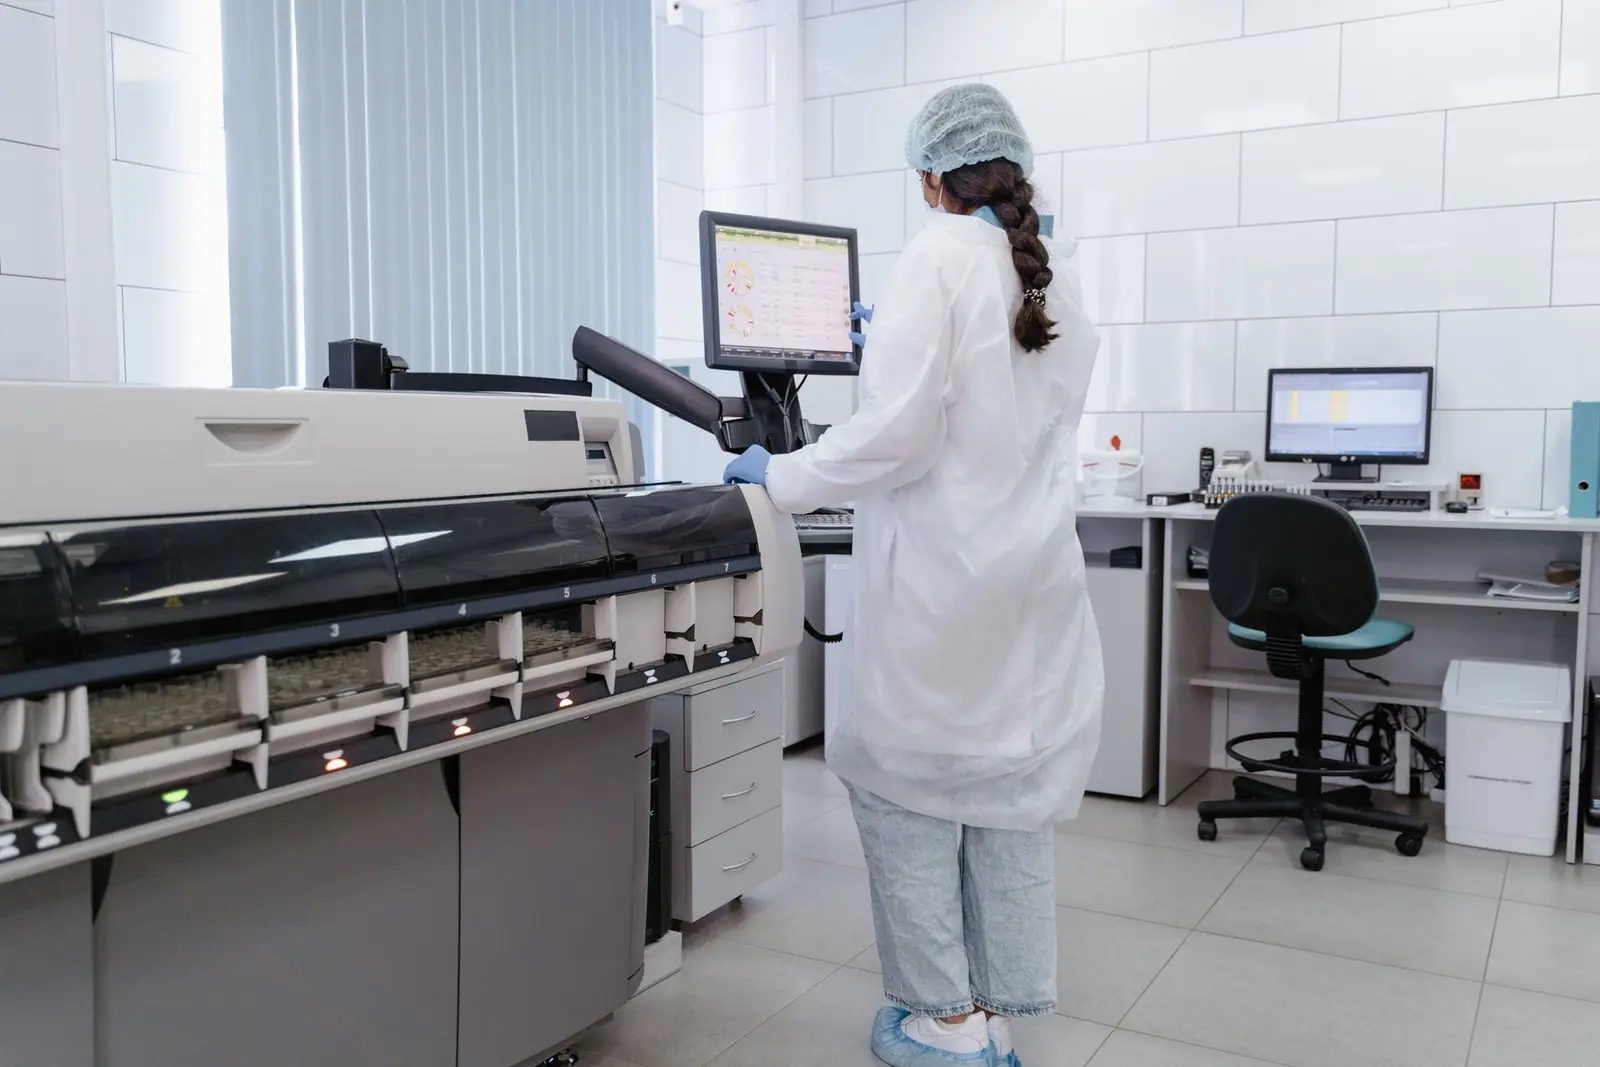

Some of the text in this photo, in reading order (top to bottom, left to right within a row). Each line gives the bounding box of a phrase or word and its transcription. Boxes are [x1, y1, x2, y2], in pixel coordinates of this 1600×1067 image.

[724, 563, 730, 573] 7
[650, 574, 657, 584] 6
[563, 587, 570, 598] 5
[458, 603, 467, 616] 4
[330, 623, 340, 637] 3
[170, 648, 182, 665] 2
